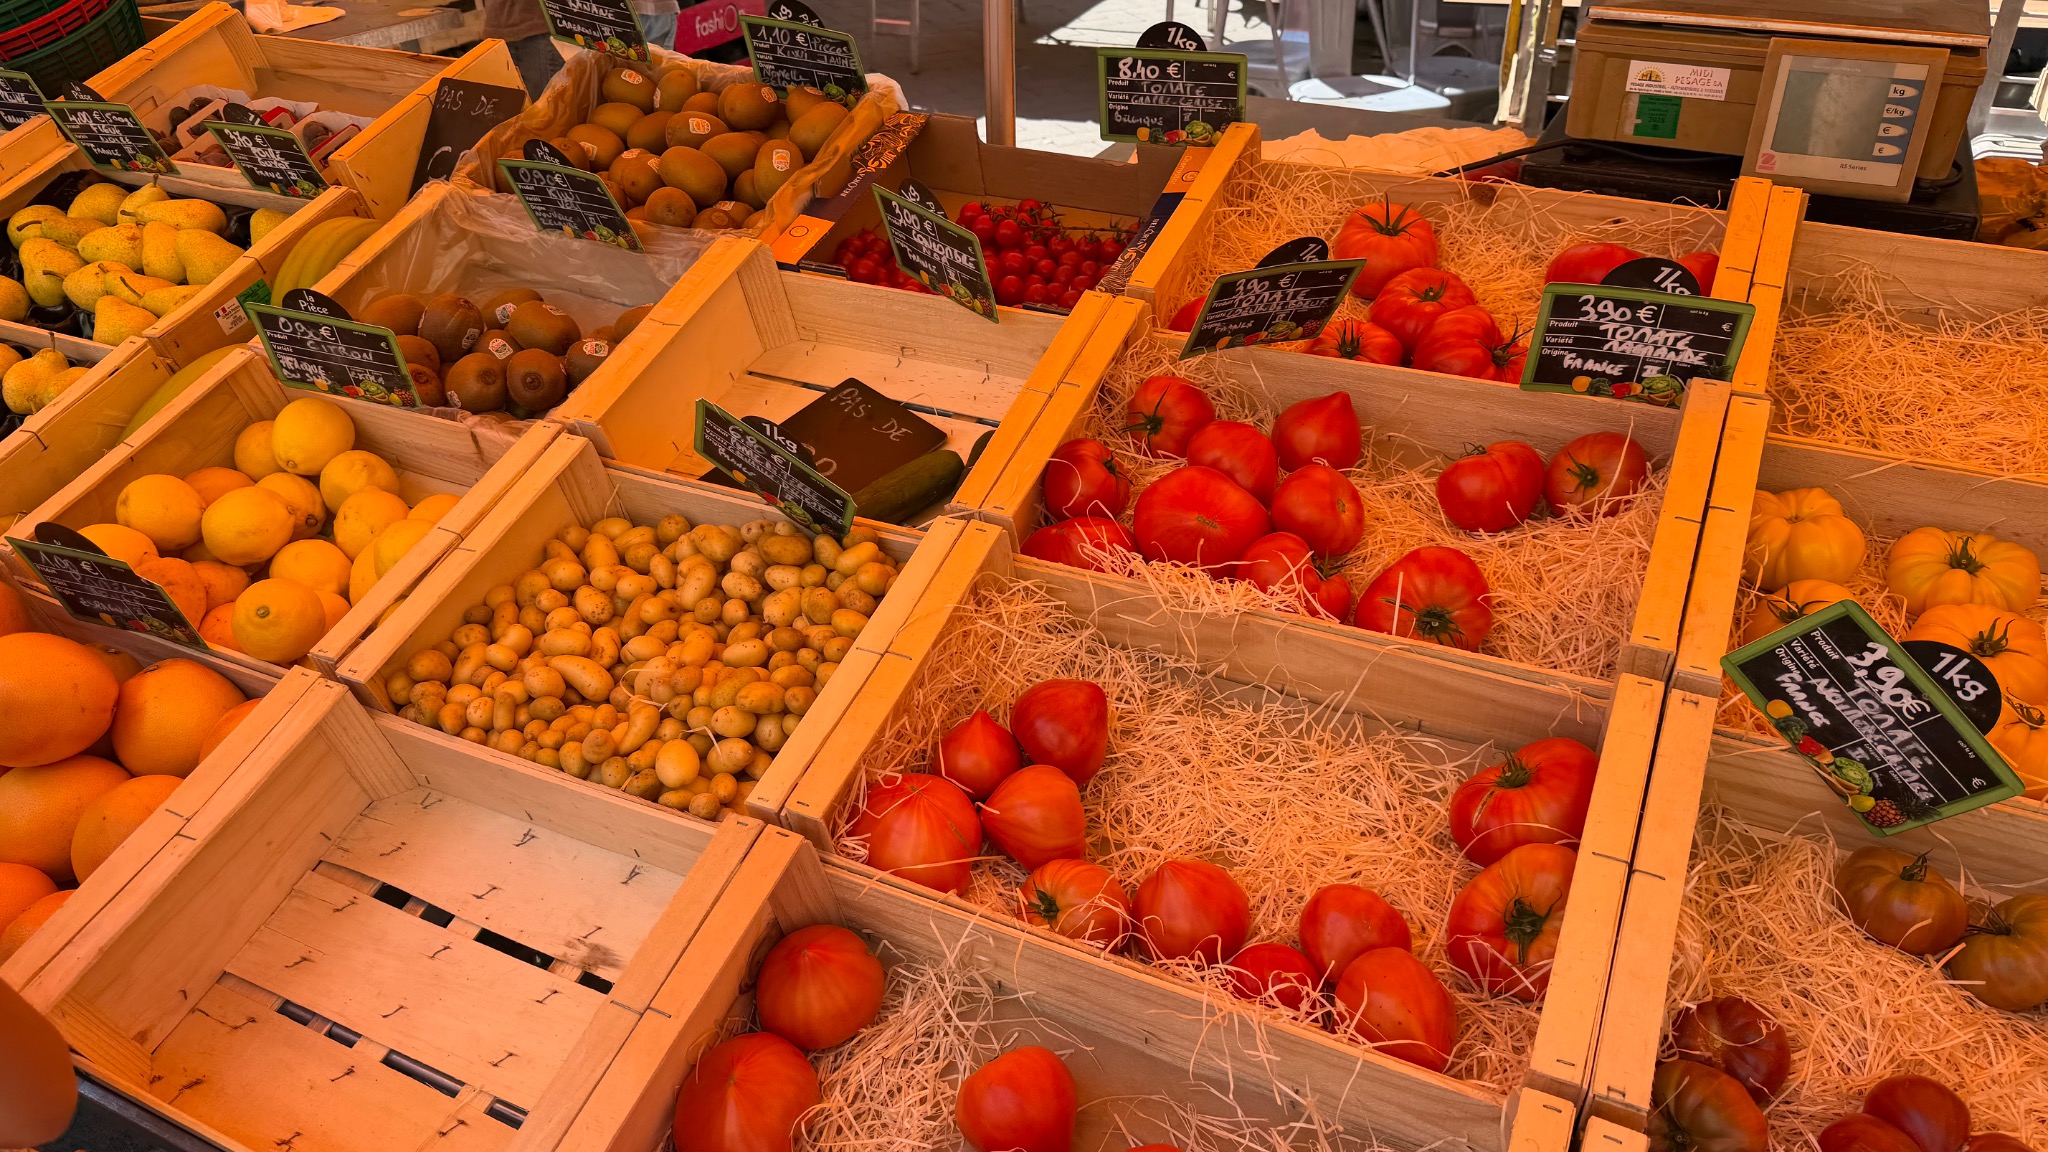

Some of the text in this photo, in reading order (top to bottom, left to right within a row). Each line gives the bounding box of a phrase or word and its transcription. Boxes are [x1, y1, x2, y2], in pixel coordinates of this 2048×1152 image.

[795, 33, 808, 47] €
[1166, 62, 1182, 78] €
[1689, 69, 1714, 78] MIDI
[1108, 79, 1129, 87] Produit
[1675, 76, 1711, 87] PESAGE
[1893, 86, 1905, 96] kg
[1108, 103, 1129, 112] Origine
[1885, 107, 1905, 116] €/kg
[1882, 126, 1891, 135] €
[1277, 273, 1295, 289] €
[303, 290, 315, 303] la
[299, 299, 329, 315] Pièce
[1636, 305, 1658, 324] €
[1549, 320, 1578, 329] Produit
[1721, 322, 1733, 332] €
[319, 325, 336, 341] €
[1545, 335, 1574, 344] Variété
[1599, 322, 1694, 349] TOMATE
[306, 340, 374, 362] CITRON
[1541, 348, 1569, 358] Origine
[1563, 352, 1629, 376] FRANCE
[830, 387, 913, 442] PAS DE
[761, 422, 798, 454] 1kg
[771, 453, 787, 470] €
[1810, 630, 1840, 661] Produit
[1789, 639, 1821, 671] Variété
[1931, 652, 1989, 702] 1kg
[1900, 697, 1932, 721] €
[1971, 777, 1987, 789] €
